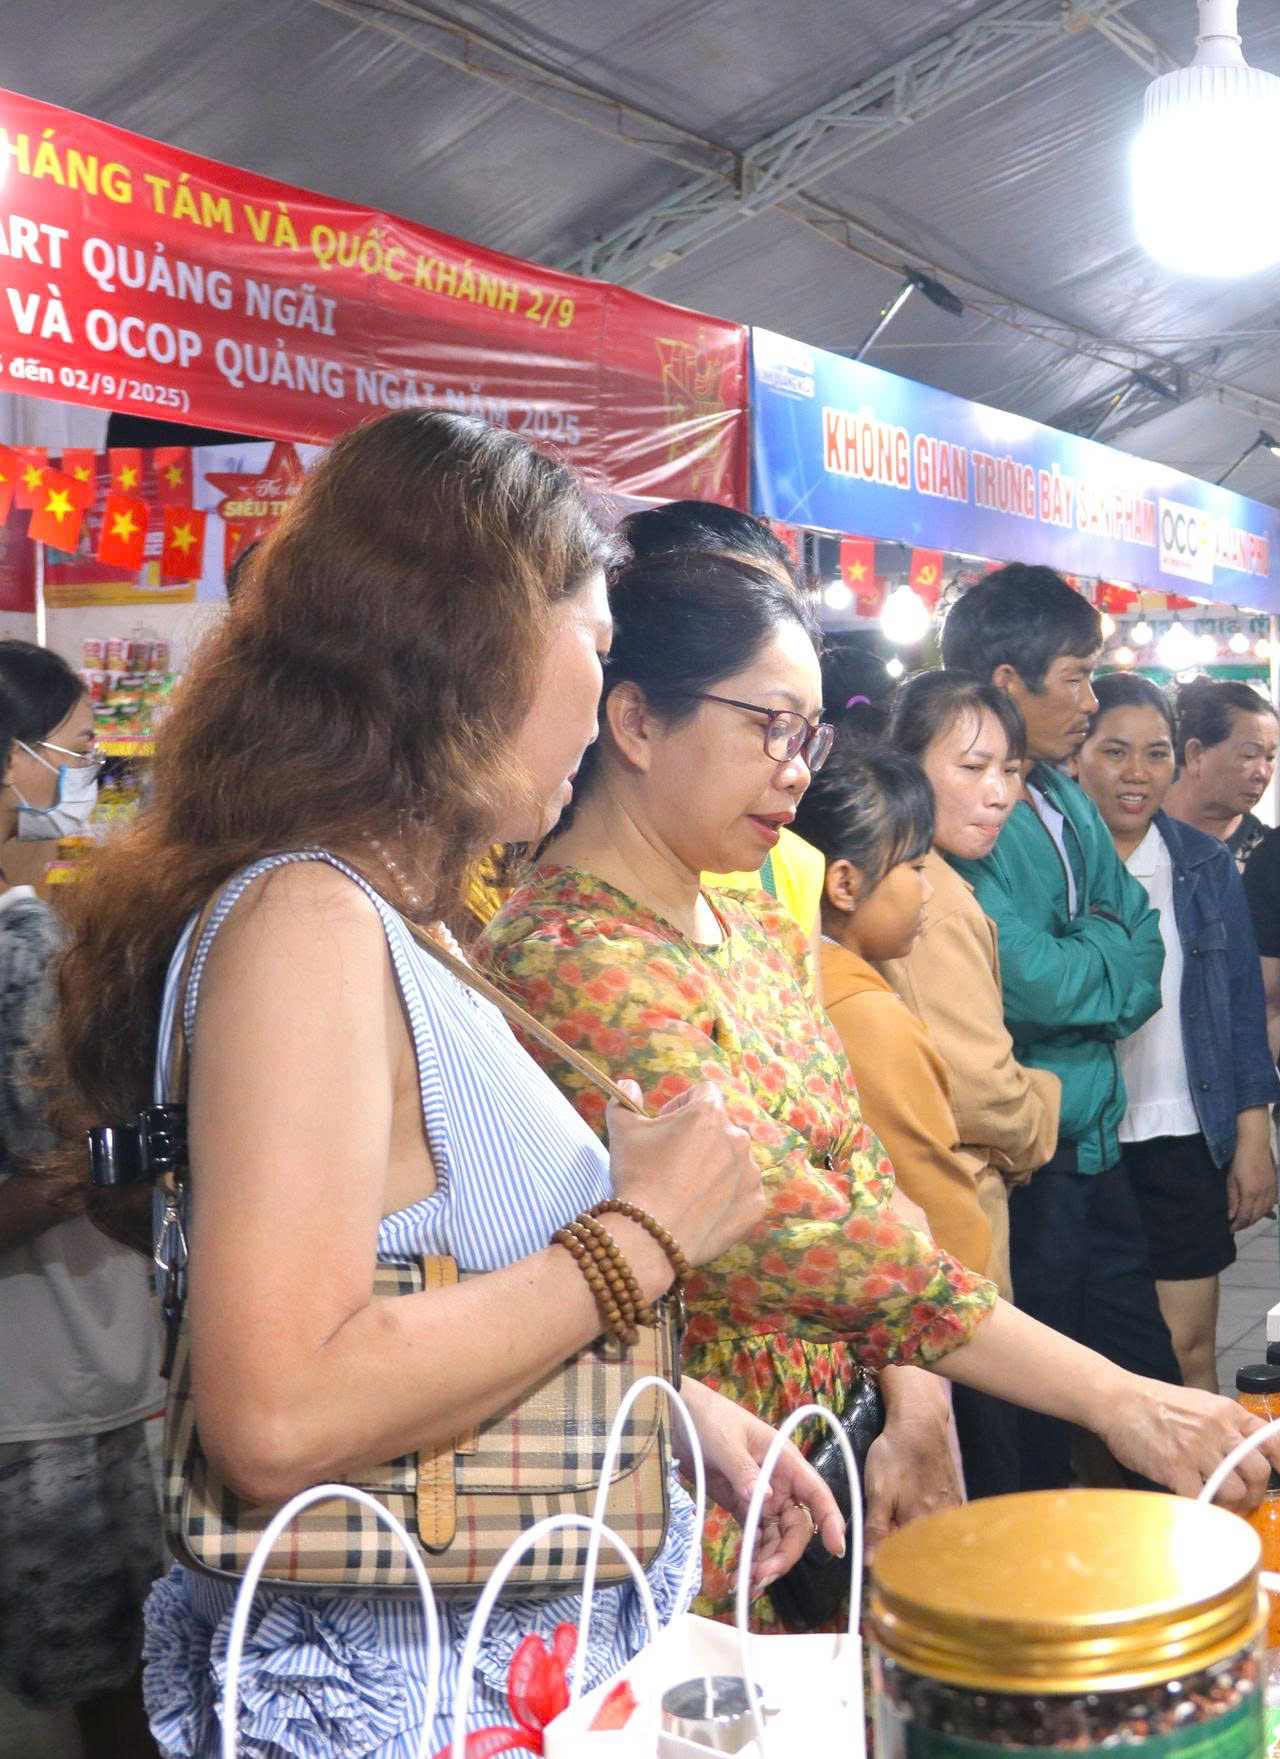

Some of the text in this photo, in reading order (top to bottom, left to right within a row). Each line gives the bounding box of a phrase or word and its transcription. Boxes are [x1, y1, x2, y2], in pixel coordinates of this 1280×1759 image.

[82, 237, 233, 310] QUẢNG
[245, 279, 337, 336] NGÃI
[144, 172, 234, 234] TÁM
[243, 201, 300, 251] VÀ
[414, 255, 519, 313] KHÁNH
[525, 288, 575, 328] 2/9
[6, 283, 73, 344] VÀ
[85, 308, 202, 367] OCOP
[215, 337, 344, 398] QUẢNG
[518, 405, 582, 446] 2025
[59, 366, 190, 413] 02/9/2025)
[824, 406, 910, 487] KHÔNG
[915, 435, 968, 501] GIAN
[972, 452, 1035, 517] TRƯNG
[1039, 466, 1072, 526] BÀY
